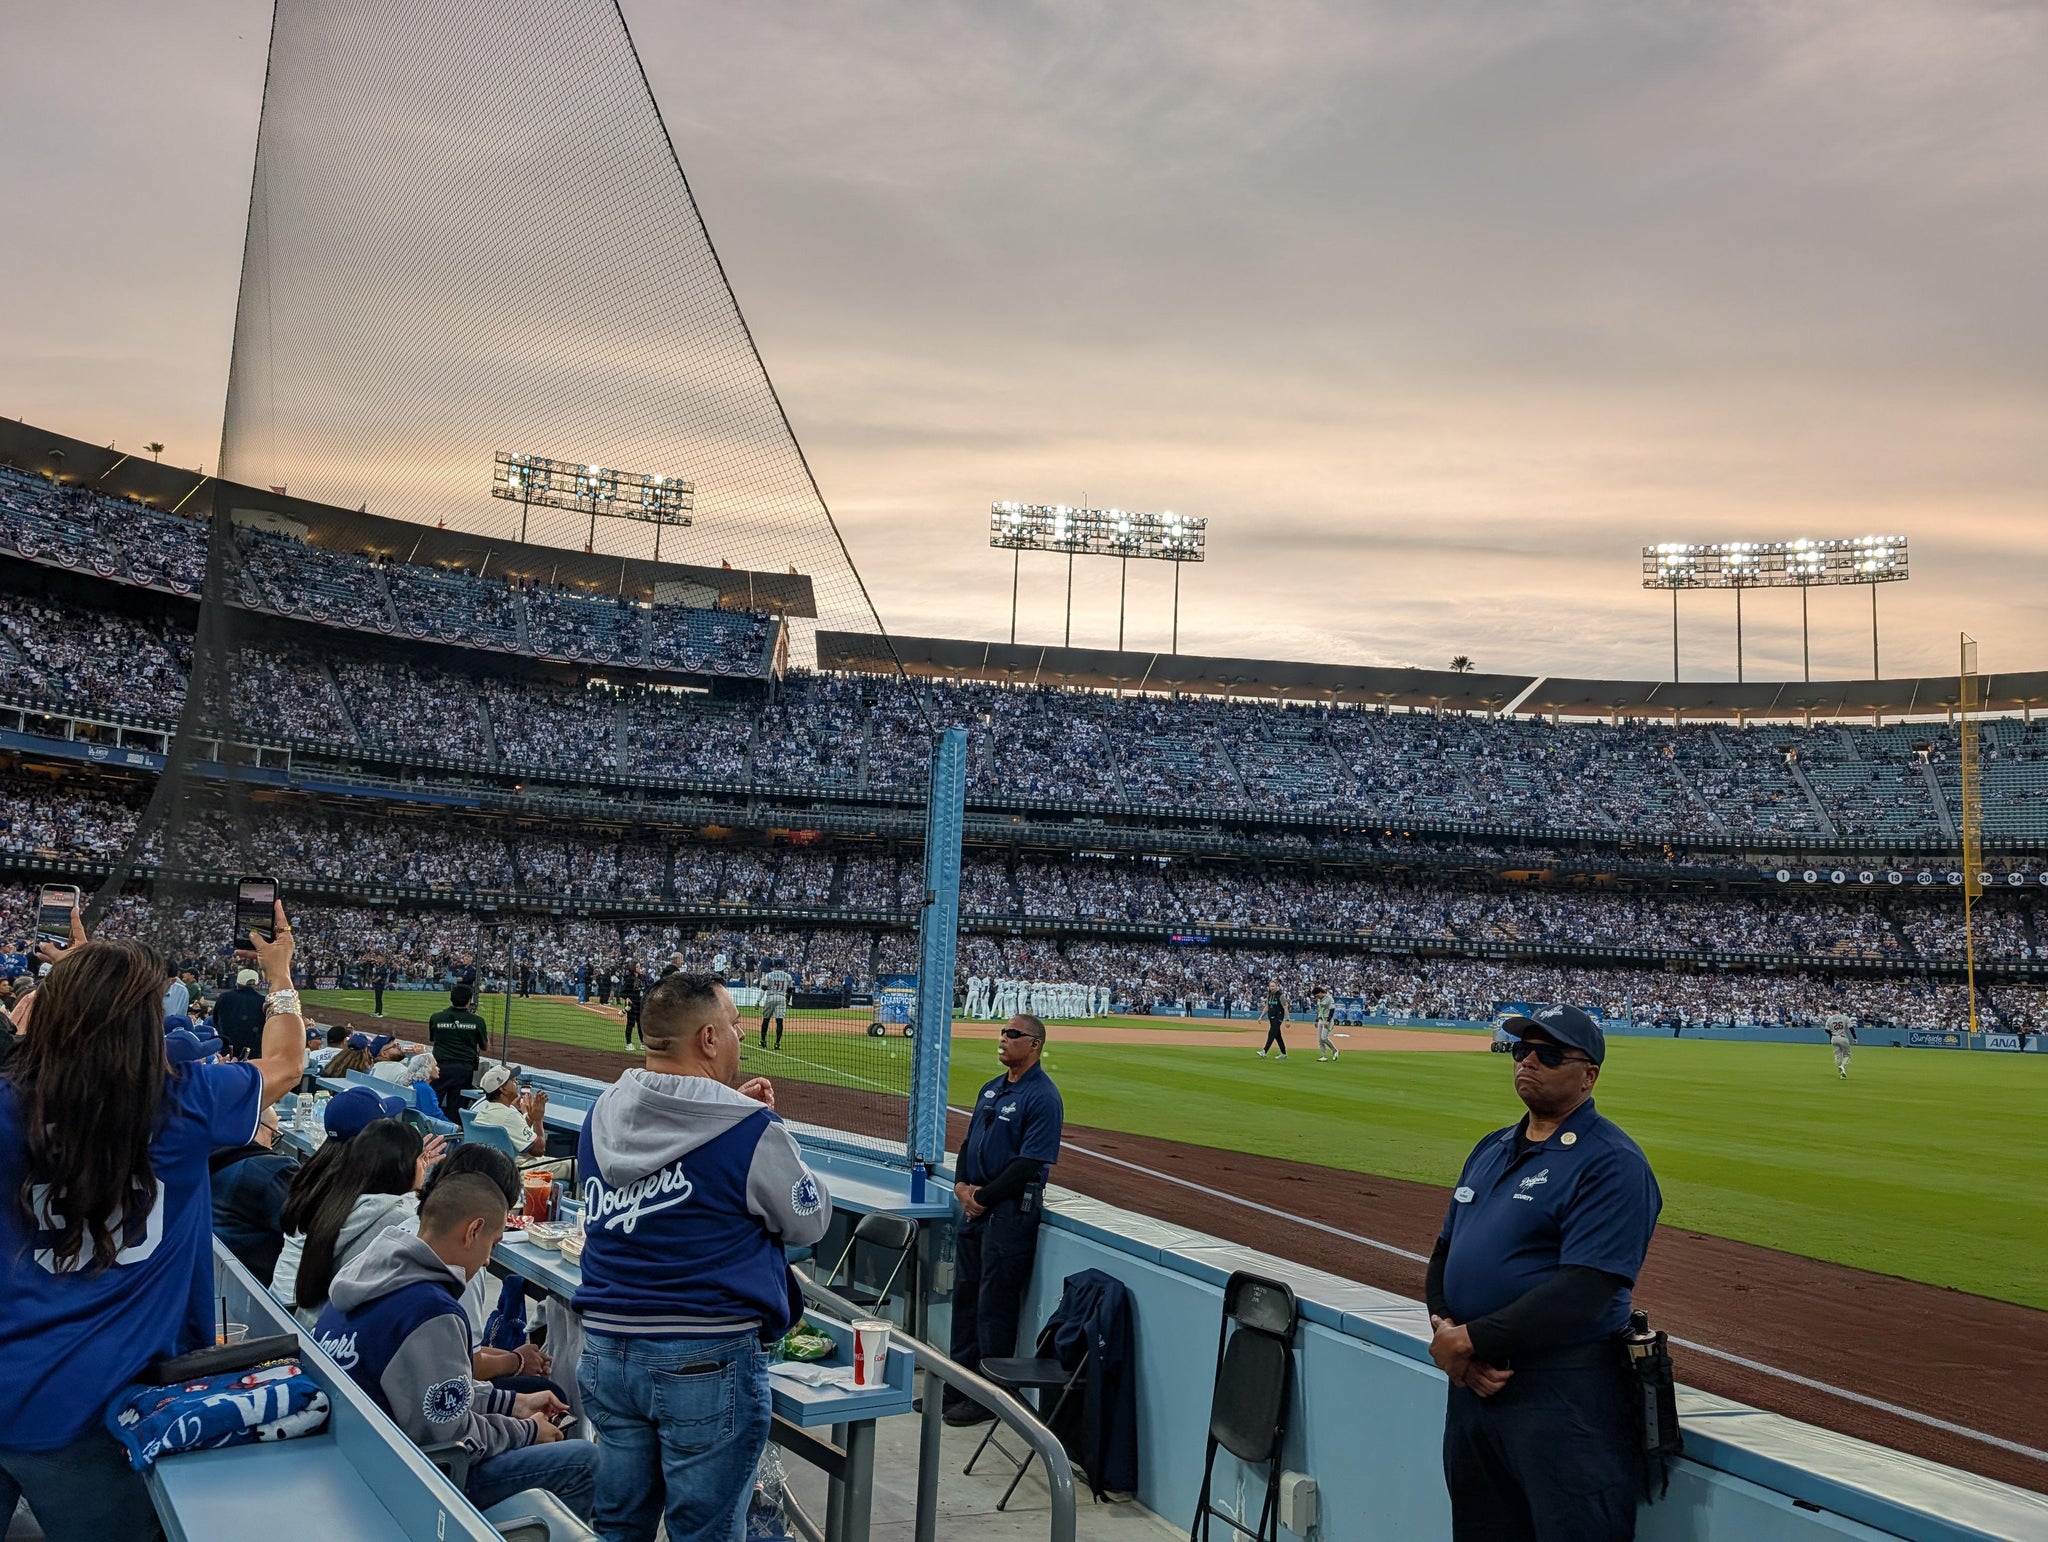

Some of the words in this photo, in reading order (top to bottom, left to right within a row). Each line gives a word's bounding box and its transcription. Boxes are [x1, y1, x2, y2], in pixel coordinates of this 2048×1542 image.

[1861, 873, 1871, 882] 14
[1890, 873, 1900, 883] 19
[1919, 874, 1931, 883] 20
[1948, 874, 1961, 883] 24
[1979, 875, 1991, 883] 32
[2010, 875, 2022, 884] 34
[1833, 1021, 1844, 1031] 26
[1911, 1032, 1942, 1044] Surfside
[1990, 1038, 2017, 1049] ANA
[584, 1161, 693, 1234] Dodgers
[444, 1391, 457, 1409] LA
